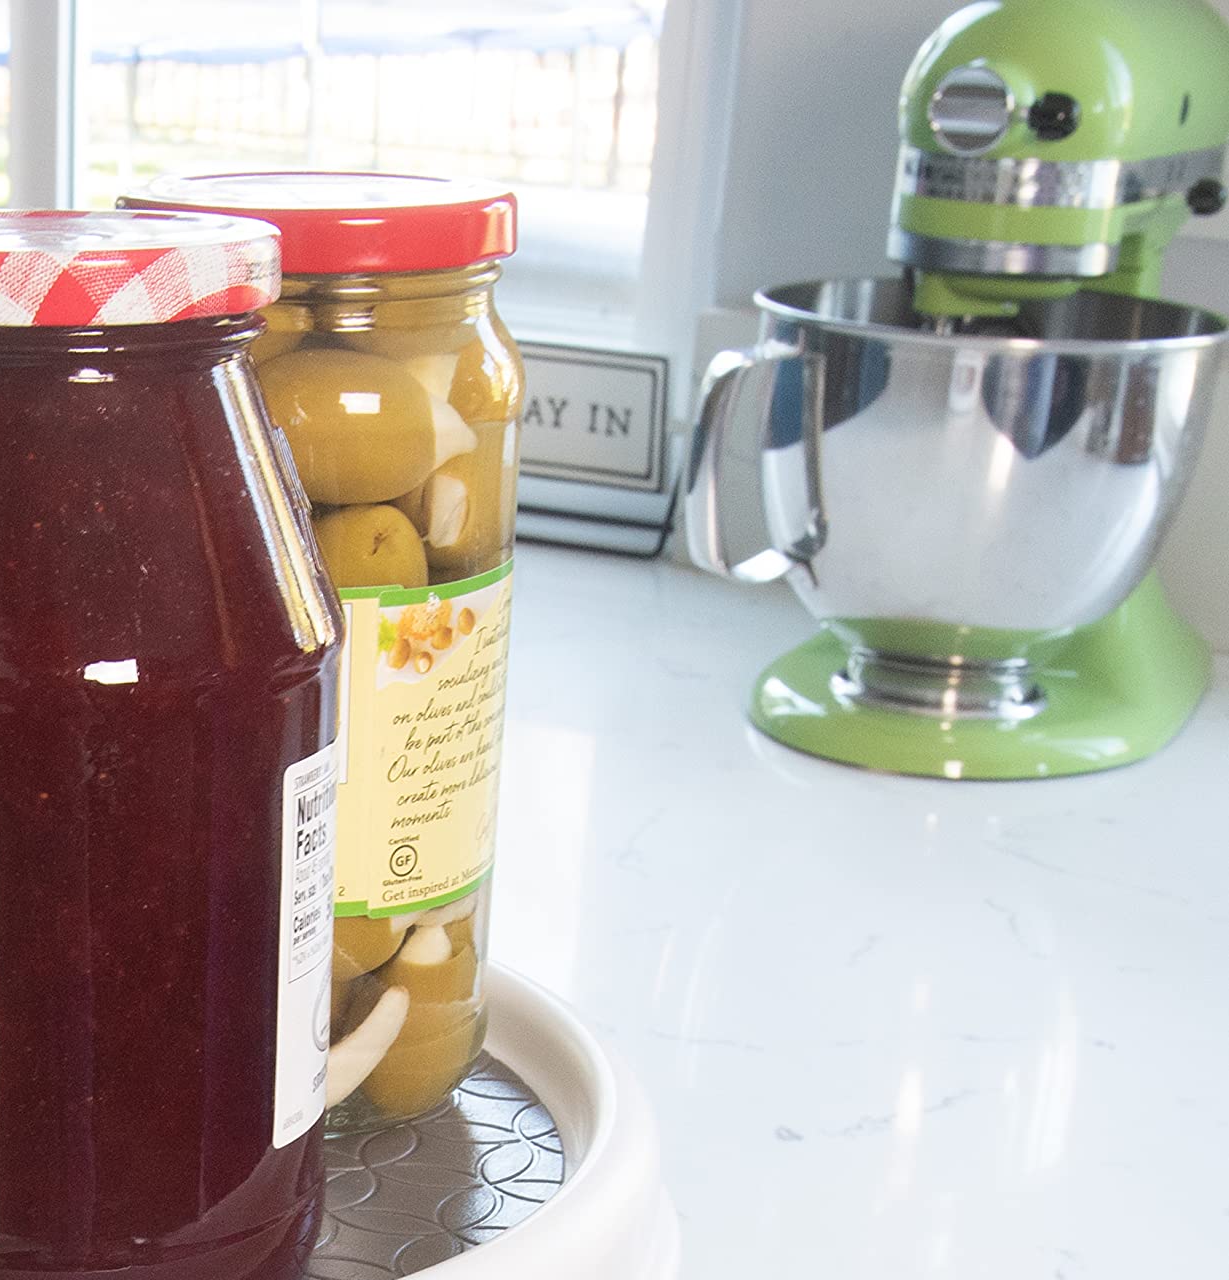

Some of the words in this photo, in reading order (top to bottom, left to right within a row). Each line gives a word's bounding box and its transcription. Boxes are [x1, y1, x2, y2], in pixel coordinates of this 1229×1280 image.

[524, 397, 568, 428] AY
[589, 404, 632, 437] IN
[393, 712, 413, 725] on
[415, 697, 453, 722] olives
[404, 726, 422, 751] be
[422, 750, 457, 776] olives
[390, 799, 454, 830] moments
[296, 820, 326, 860] Facts
[395, 854, 413, 867] GF
[337, 886, 345, 897] 2
[382, 889, 405, 903] Get
[408, 876, 450, 899] inspired
